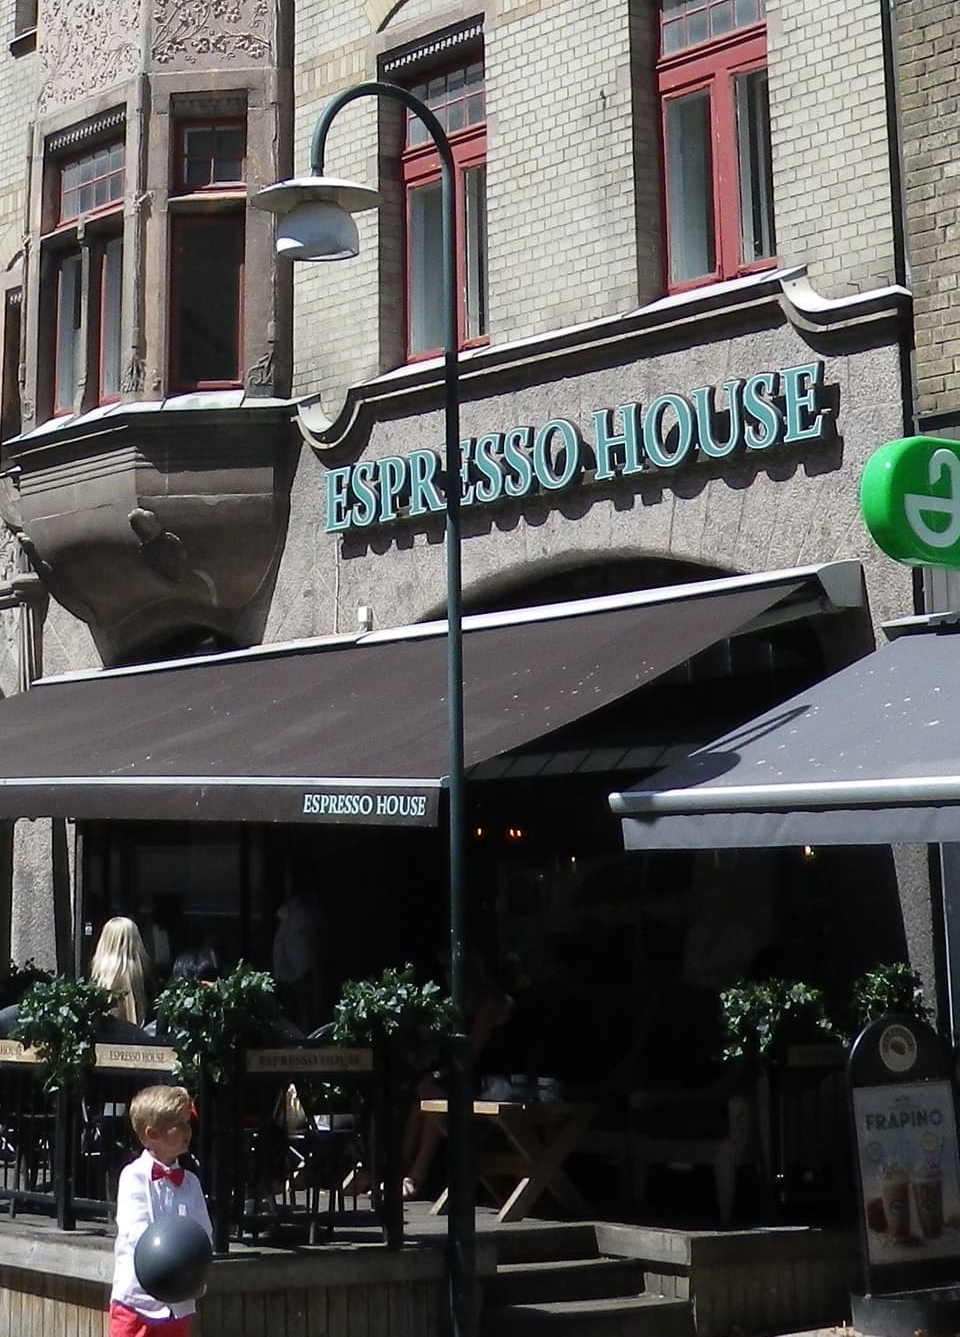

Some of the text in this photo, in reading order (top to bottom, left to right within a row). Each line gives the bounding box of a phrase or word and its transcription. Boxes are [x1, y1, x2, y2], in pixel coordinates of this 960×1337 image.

[324, 361, 825, 533] ESPRESSO HOUSE
[303, 794, 426, 816] ESPRESSO HOUSE
[110, 1050, 164, 1063] ESPRESSO HOUSE
[865, 1108, 944, 1131] FRAPINO
